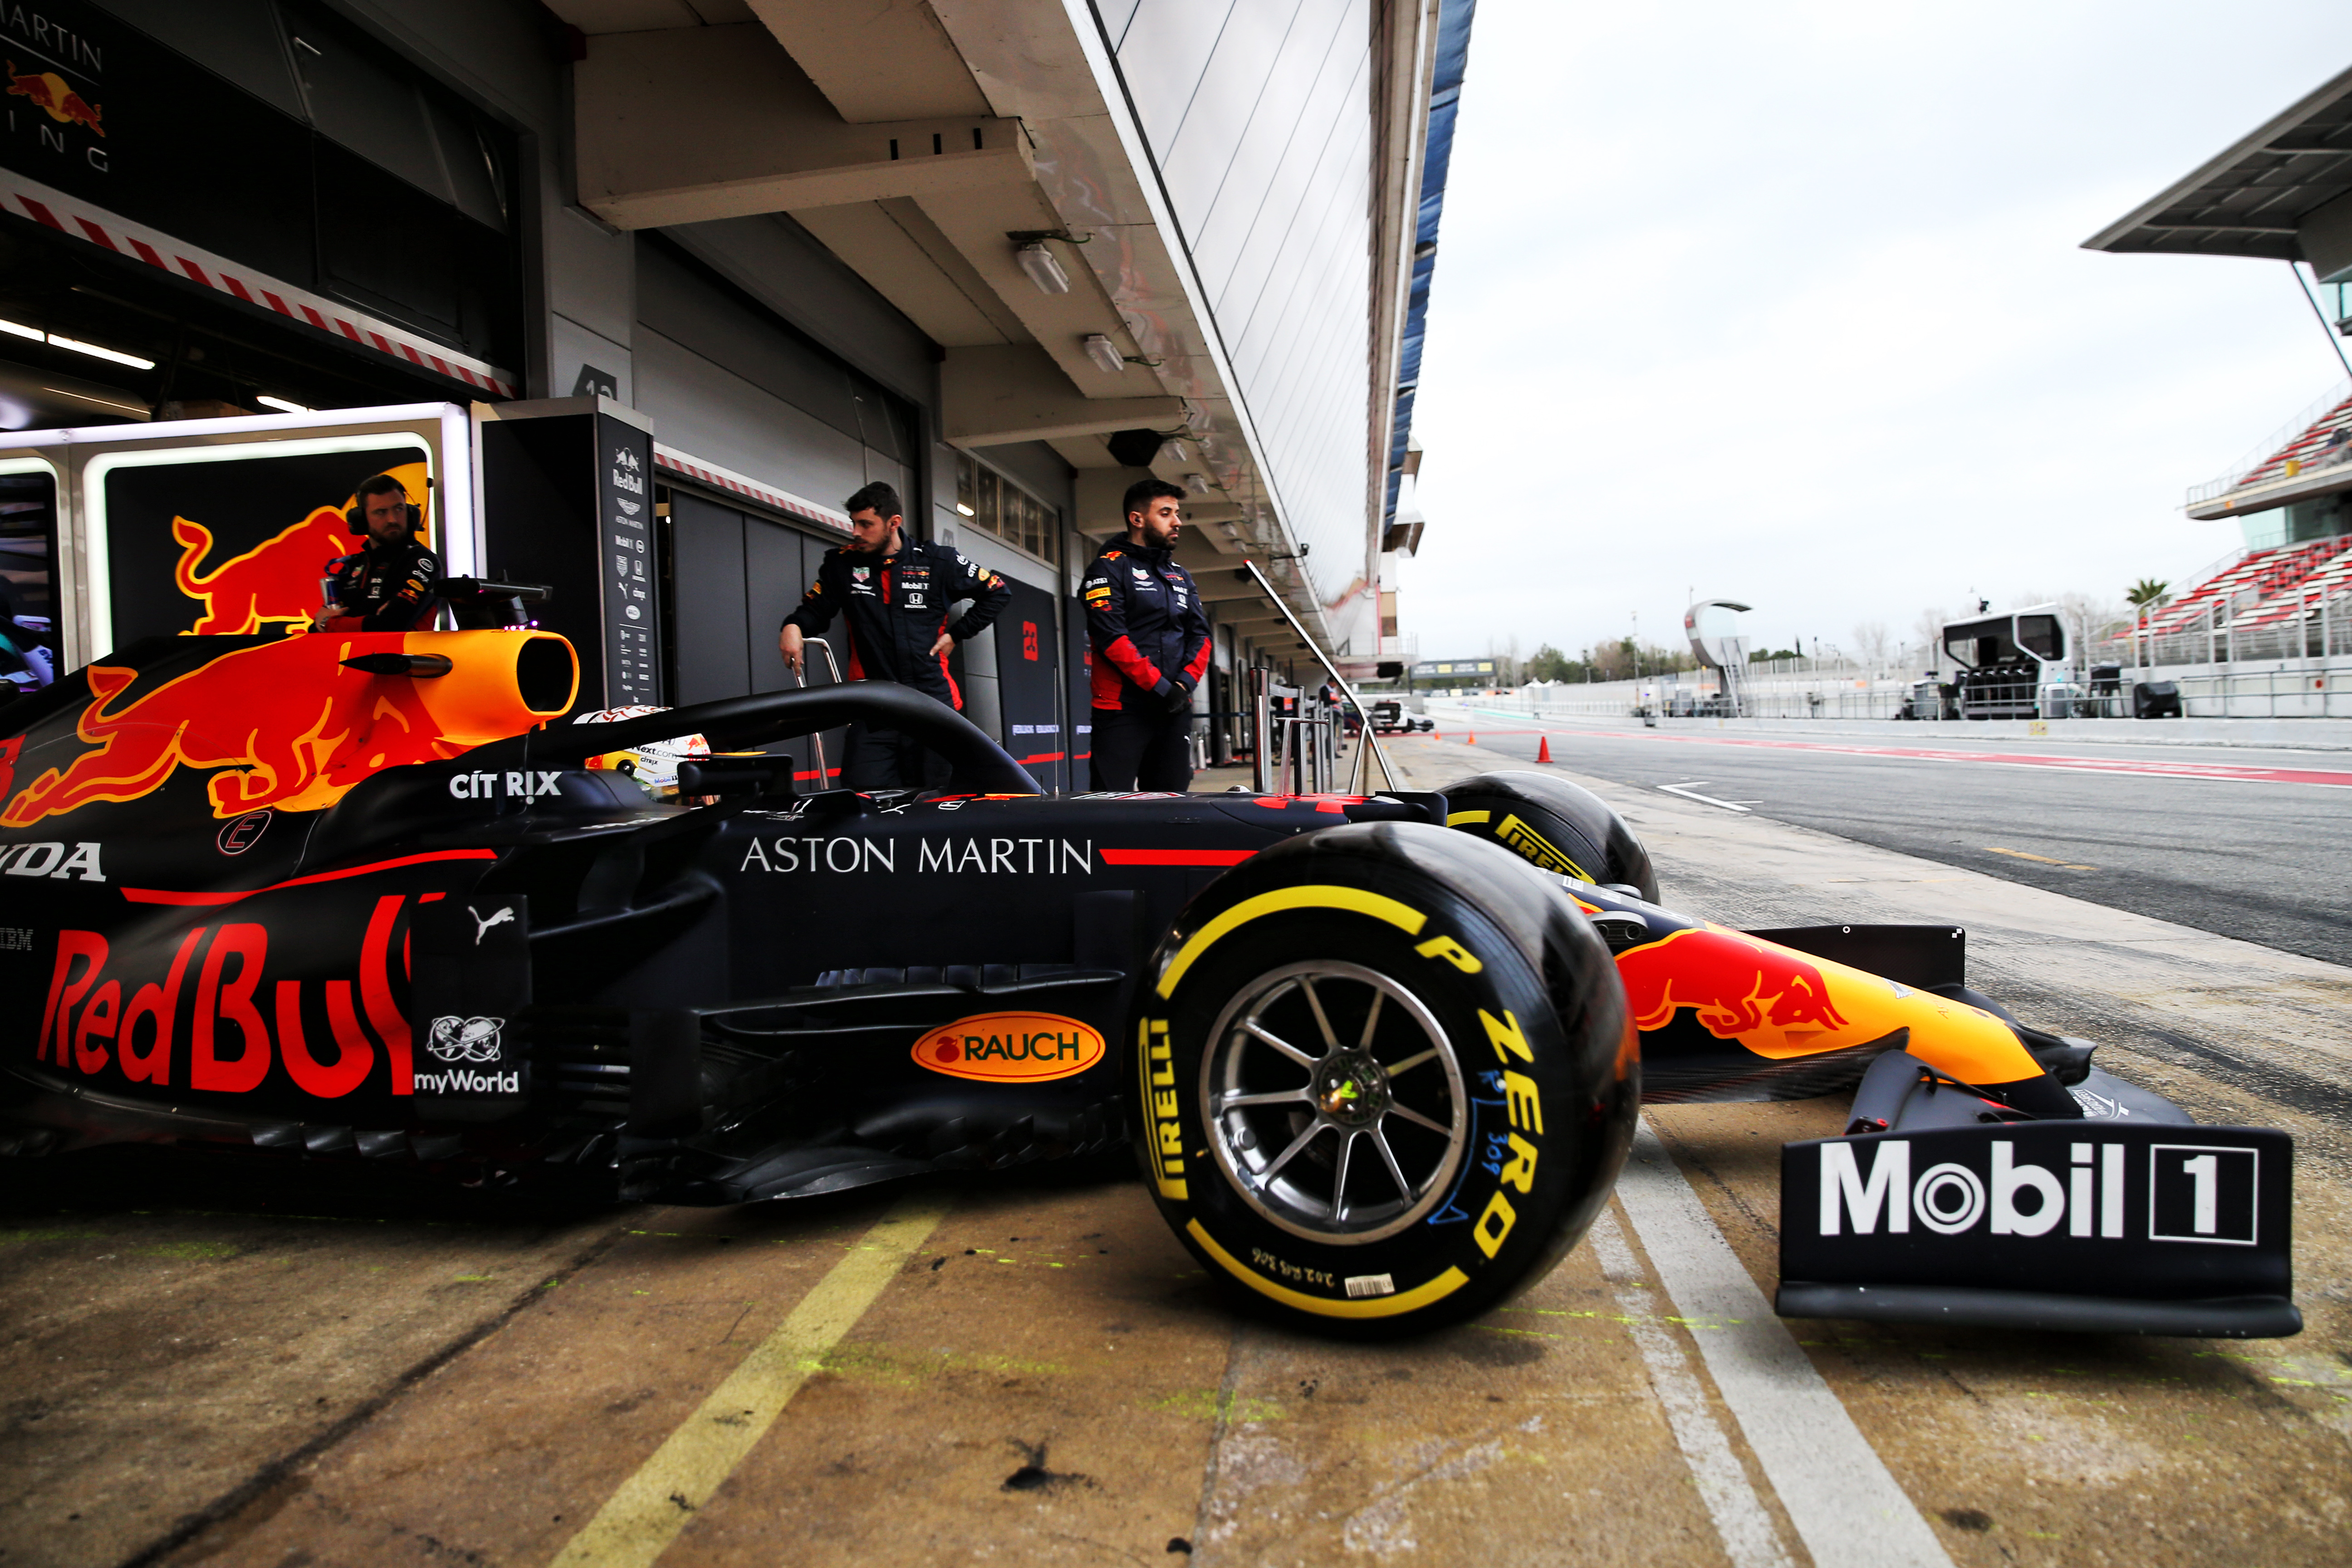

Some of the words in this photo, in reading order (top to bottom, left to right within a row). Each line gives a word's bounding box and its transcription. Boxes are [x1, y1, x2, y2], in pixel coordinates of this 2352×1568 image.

[740, 837, 894, 872] ASTON
[918, 838, 1091, 874] MARTIN
[37, 927, 207, 1086] Red
[965, 1032, 1080, 1061] RAUCH
[414, 1068, 519, 1094] myWorld
[1138, 1016, 1189, 1200] PIRELLI
[1820, 1140, 2125, 1238] Mobil
